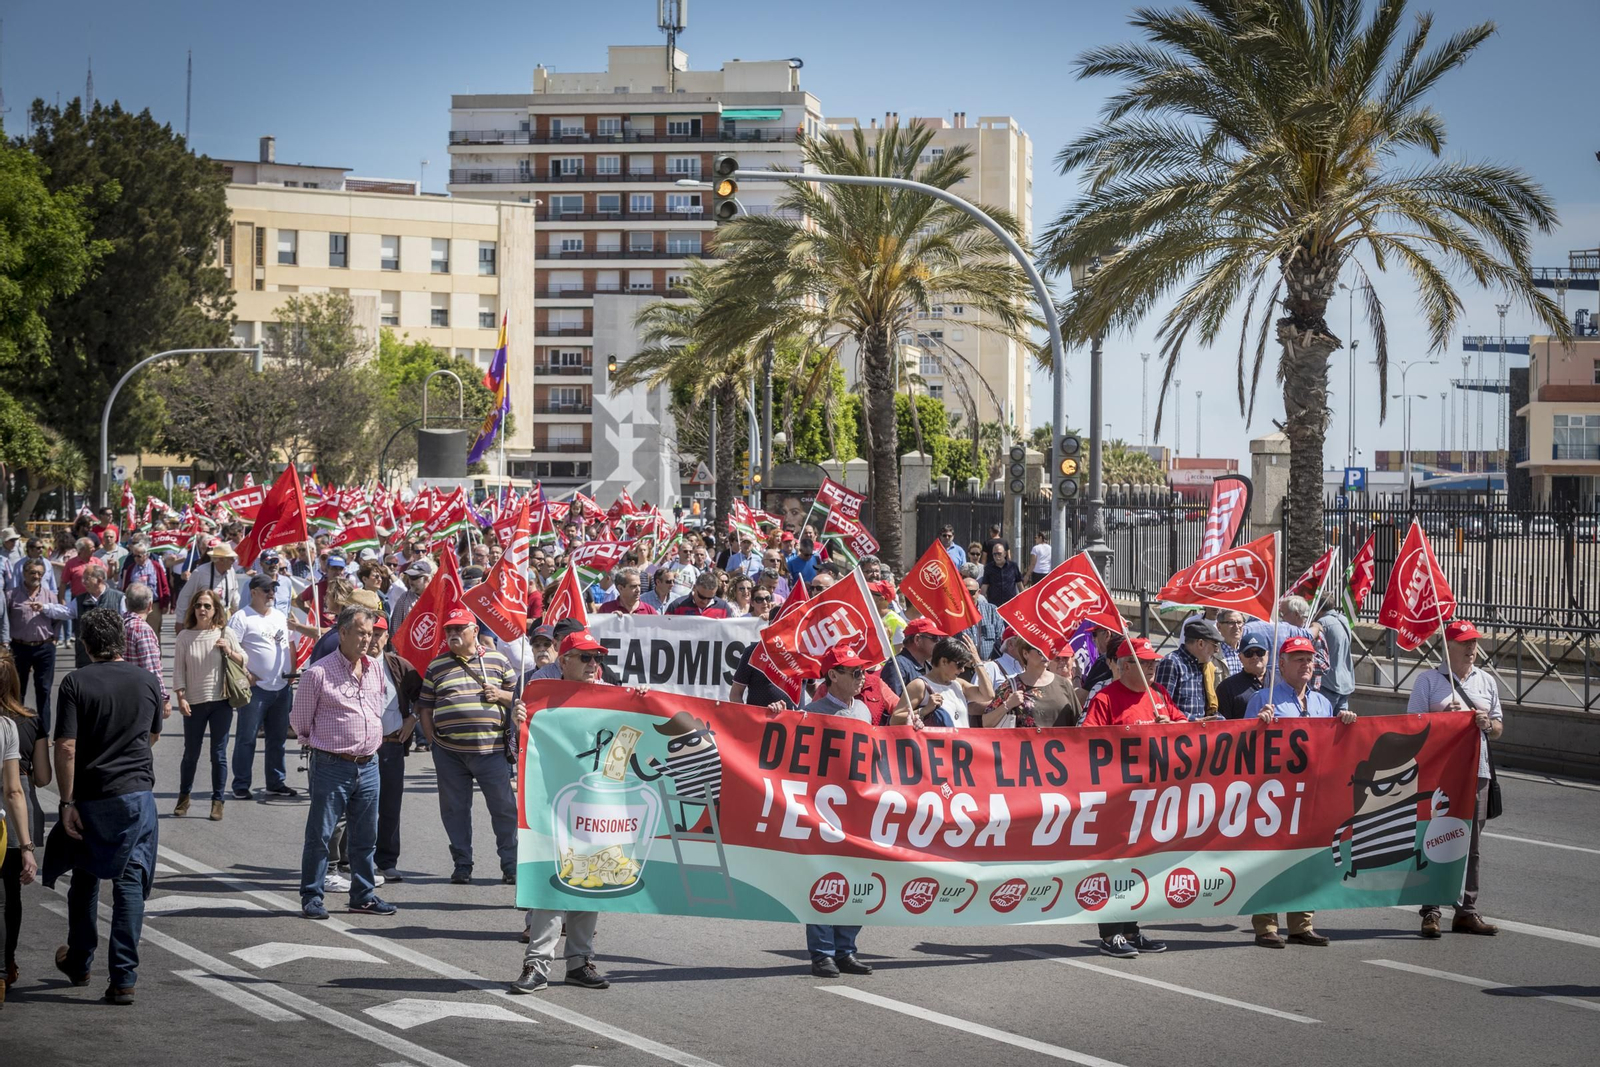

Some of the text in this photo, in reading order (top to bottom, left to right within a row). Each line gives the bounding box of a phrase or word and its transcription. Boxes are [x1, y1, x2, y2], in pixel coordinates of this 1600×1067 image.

[1349, 470, 1361, 486] P
[823, 483, 861, 510] CCOO
[923, 562, 946, 582] UGT
[1199, 556, 1254, 583] UGT
[1041, 577, 1100, 623] UGT
[412, 614, 436, 643] UGT
[801, 606, 866, 657] UGT
[1013, 609, 1060, 657] www.ugt.es
[759, 722, 1309, 787] DEFENDER LAS PENSIONES
[576, 816, 638, 833] PENSIONES
[870, 791, 1011, 848] COSA
[1032, 791, 1107, 846] DE
[1426, 828, 1465, 850] PENSIONES
[815, 879, 847, 896] UGT
[853, 883, 874, 896] UJP
[905, 880, 938, 896] UGT
[996, 884, 1027, 896] UGT
[1030, 886, 1052, 896] UJP
[1079, 876, 1107, 894] UGT
[1115, 880, 1136, 892] UJP
[1168, 875, 1196, 891] UGT
[1203, 879, 1224, 890] UJP
[942, 887, 966, 897] UJP
